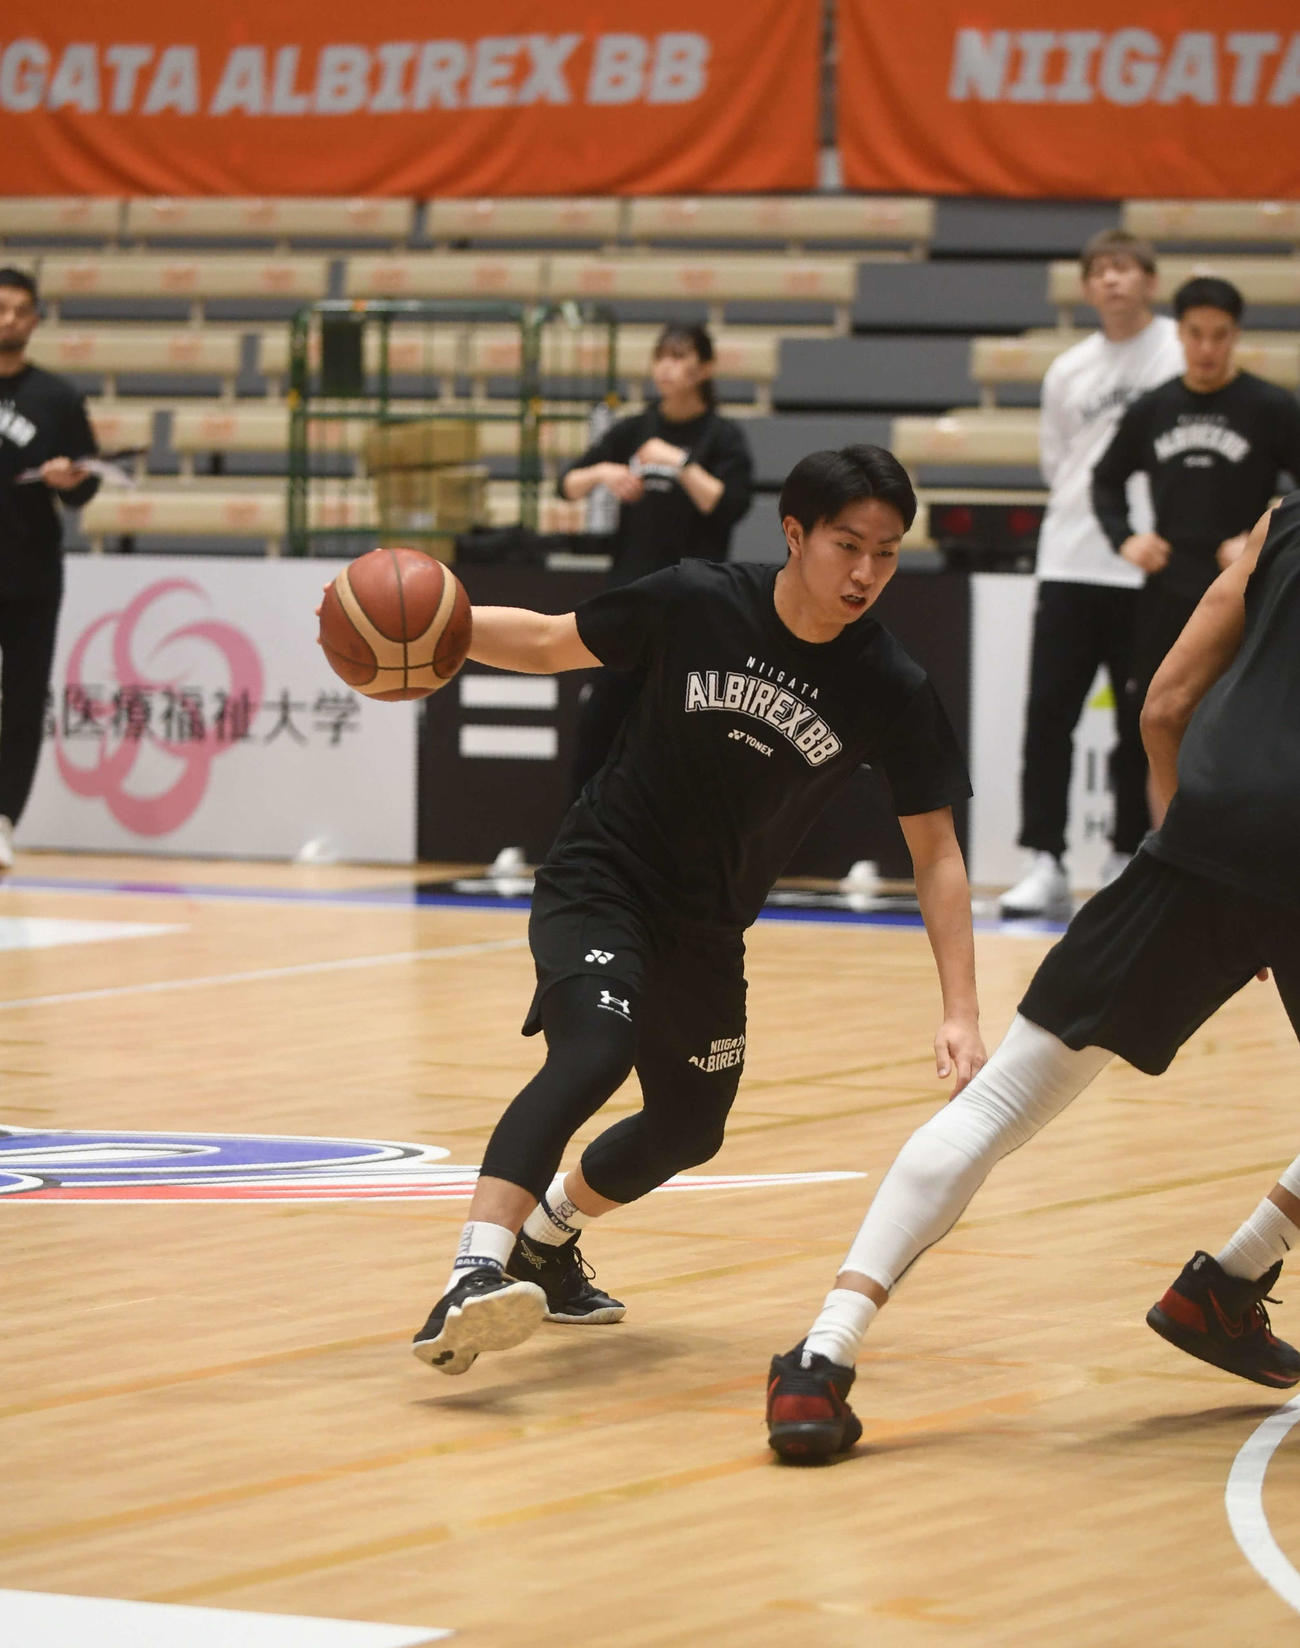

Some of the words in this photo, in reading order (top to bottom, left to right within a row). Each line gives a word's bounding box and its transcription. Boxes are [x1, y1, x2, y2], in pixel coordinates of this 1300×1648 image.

[208, 34, 584, 117] ALBIREX
[585, 31, 711, 106] BB
[746, 655, 819, 700] NIIGATA
[46, 682, 362, 746] 医療福祉大学
[744, 734, 775, 758] YONEX
